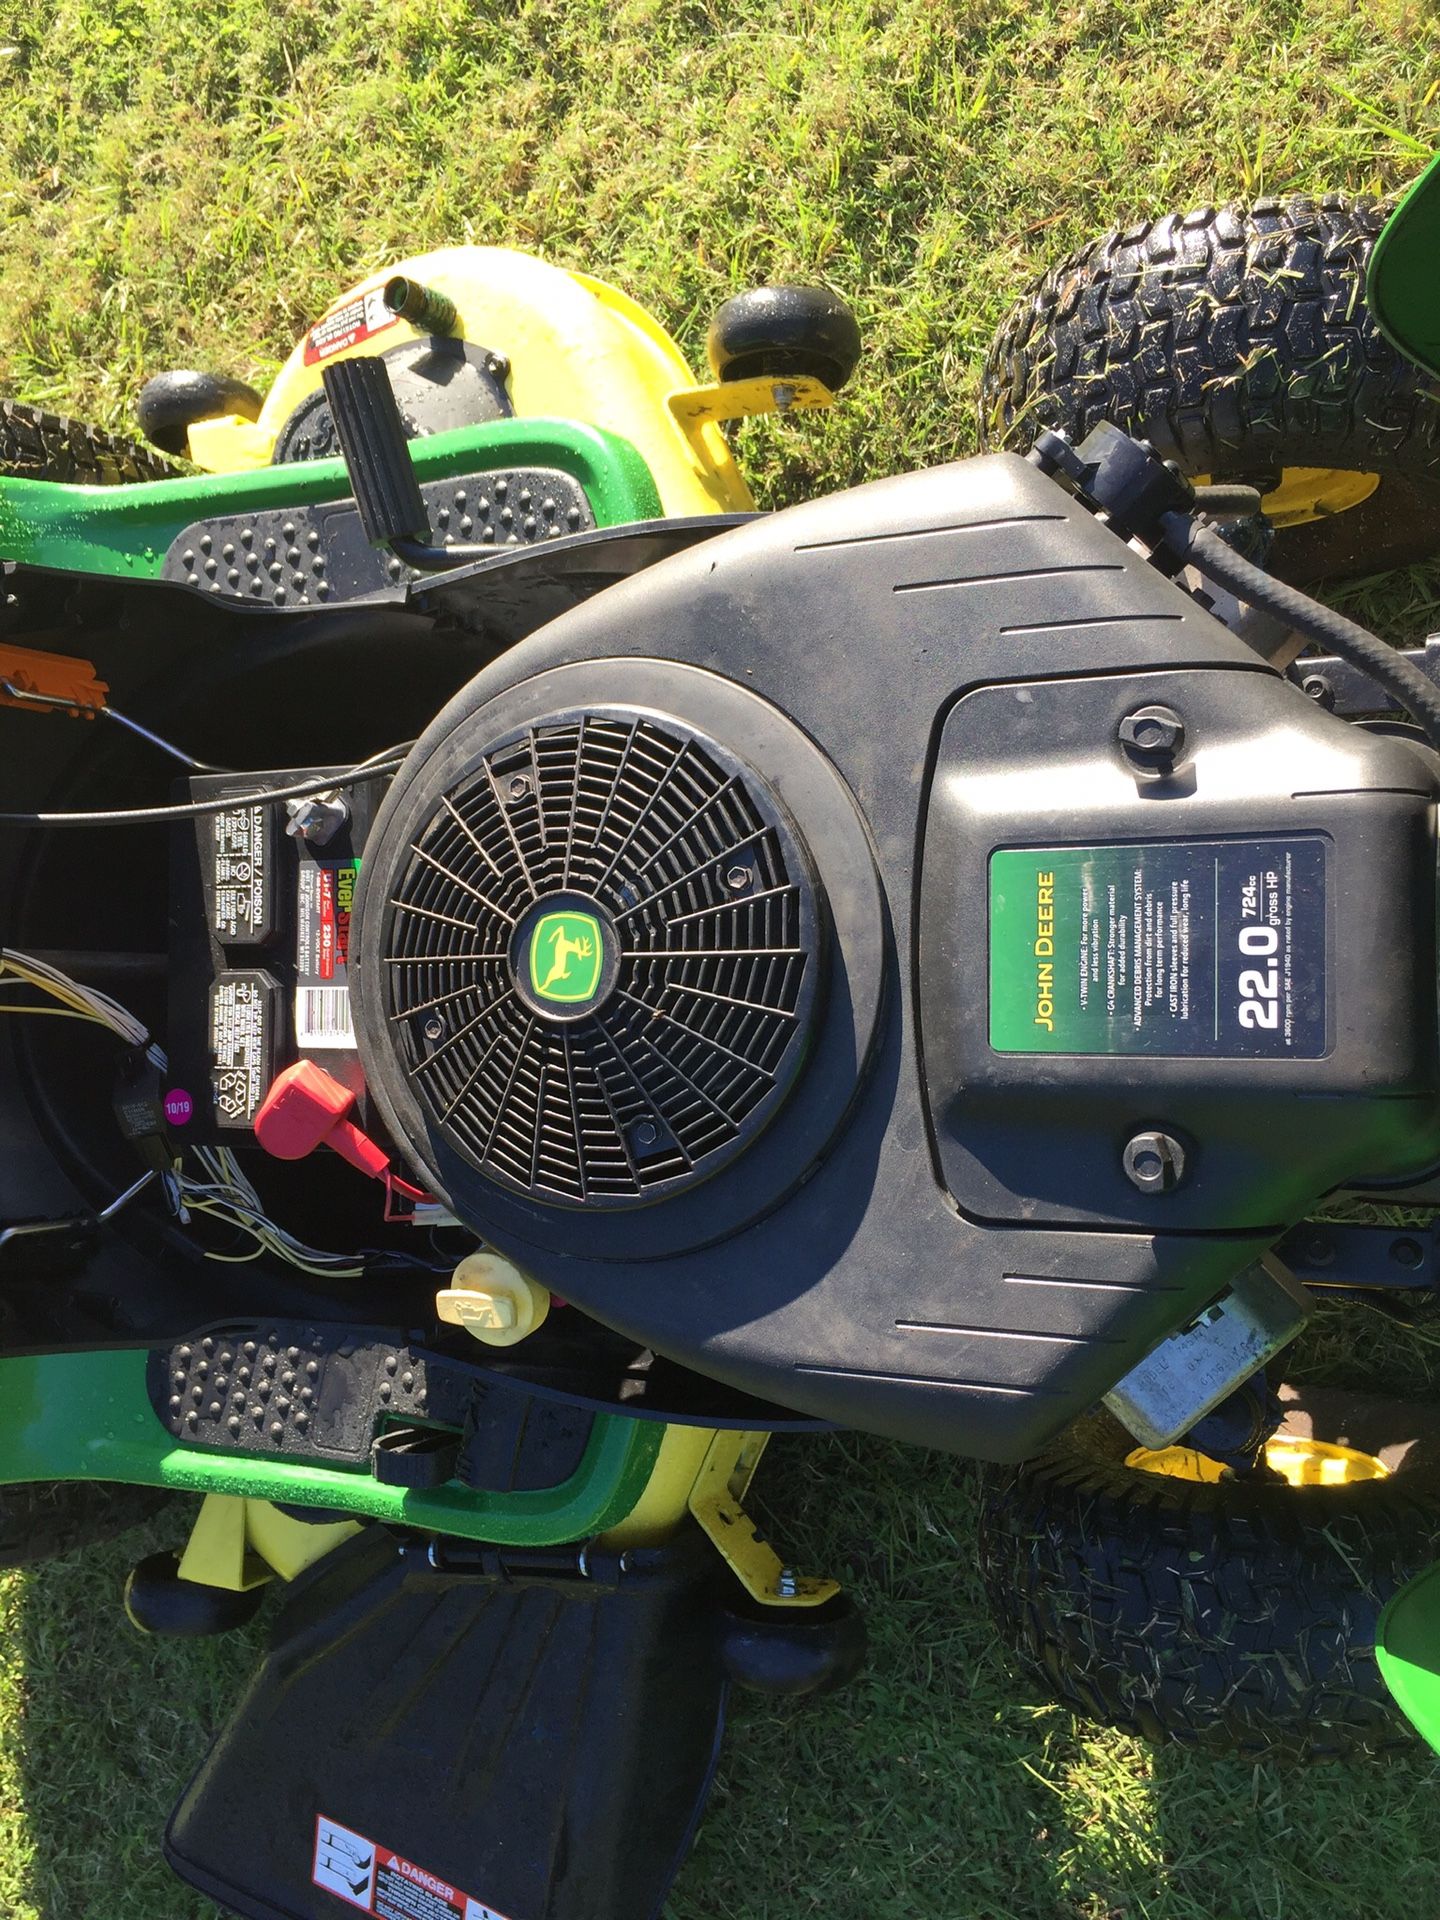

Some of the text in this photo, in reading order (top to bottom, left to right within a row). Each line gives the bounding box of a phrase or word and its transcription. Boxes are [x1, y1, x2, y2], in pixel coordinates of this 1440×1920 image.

[230, 866, 235, 876] NO
[254, 816, 262, 924] DANGER / POISON
[1082, 888, 1090, 911] power
[1171, 882, 1179, 914] pressure
[1181, 880, 1189, 892] life
[1242, 876, 1256, 917] 724cc
[1266, 871, 1280, 925] gross HP
[1181, 894, 1190, 910] long
[1108, 917, 1116, 948] Stronger
[1118, 915, 1127, 949] durability
[1155, 902, 1164, 948] performance
[1170, 915, 1178, 928] full
[323, 925, 331, 946] 230
[1081, 933, 1089, 944] For
[1091, 919, 1099, 952] vibration
[1134, 869, 1142, 1026] ADVANCED DEBRIS MANAGEMENT SYSTEM:
[1170, 930, 1178, 943] and
[1035, 871, 1054, 1032] JOHN DEERE
[1081, 946, 1089, 976] ENGINE:
[1091, 953, 1099, 966] less
[1118, 951, 1126, 972] added
[1145, 893, 1153, 1006] Protection from dirt and debris
[1170, 945, 1178, 971] sleeves
[1181, 935, 1189, 964] reduced
[1155, 969, 1164, 985] long
[1181, 965, 1189, 977] for
[1238, 927, 1278, 1028] 22.0
[1081, 978, 1089, 1005] V-TWIN
[1108, 1000, 1115, 1010] G4
[1155, 987, 1163, 998] for
[1181, 979, 1189, 1019] lubrication
[166, 1101, 190, 1115] 10/19
[390, 1871, 424, 1894] ROTATING
[425, 1891, 448, 1908] BLADE
[401, 1862, 454, 1901] DANGER
[387, 1887, 416, 1907] THROWN
